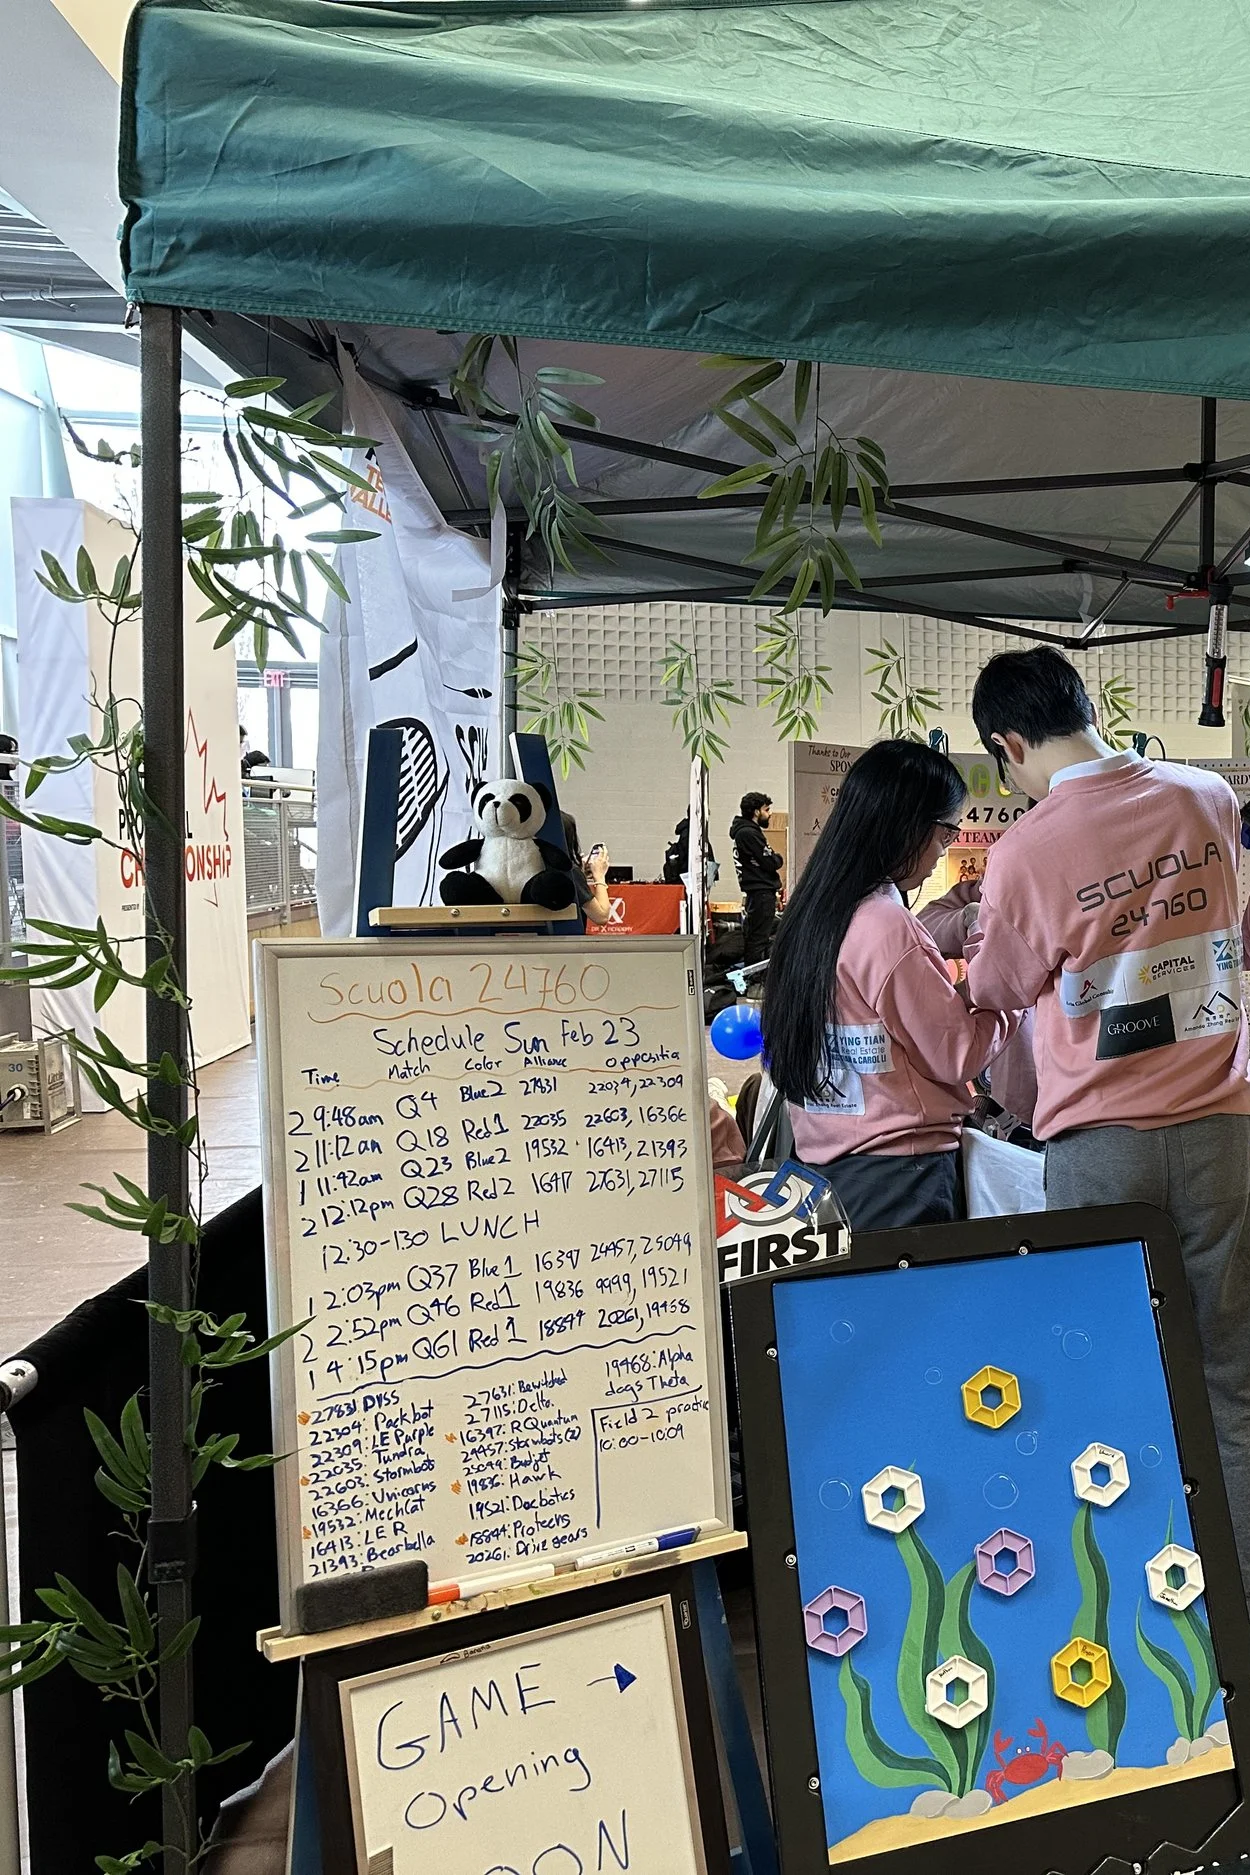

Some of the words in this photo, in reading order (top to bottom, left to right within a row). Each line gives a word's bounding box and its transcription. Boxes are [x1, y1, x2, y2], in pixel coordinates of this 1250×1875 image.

[263, 670, 287, 687] EXIT
[808, 746, 831, 758] Thanks
[832, 748, 839, 758] to
[120, 844, 232, 889] CHONSHIP
[1076, 842, 1222, 912] SCUOLA
[1111, 887, 1208, 937] 24760
[1151, 956, 1195, 973] CAPITAL
[1152, 964, 1196, 980] SERVICES
[321, 963, 452, 1006] Scuola
[469, 963, 610, 1008] 24760
[373, 1025, 485, 1056] Schedule
[504, 1022, 550, 1054] Sun
[561, 1020, 593, 1047] Feb
[602, 1017, 640, 1046] 23
[840, 1036, 861, 1046] YING
[864, 1034, 886, 1046] TIAN
[1107, 1015, 1161, 1036] GROOVE
[8, 1063, 23, 1073] 30
[301, 1068, 340, 1086] Time
[389, 1057, 431, 1080] Match
[464, 1056, 503, 1071] Color
[288, 1111, 313, 1135] 2
[294, 1150, 310, 1172] 2
[400, 1156, 452, 1179] Q23
[525, 1138, 569, 1162] 19532
[301, 1218, 317, 1237] 2
[403, 1185, 459, 1210] Q28
[441, 1210, 540, 1243] LUNCH
[717, 1222, 845, 1282] FIRST
[407, 1264, 458, 1292] Q37
[300, 1334, 319, 1363] 2
[407, 1295, 460, 1325] Q46
[535, 1280, 584, 1306] 19836
[642, 1268, 688, 1290] 19521
[412, 1329, 458, 1360] Q61
[646, 1370, 690, 1391] Theta
[394, 1422, 434, 1445] Purple
[600, 1407, 638, 1432] Field
[641, 1408, 659, 1419] 2
[372, 1442, 425, 1465] Tundra
[373, 1454, 435, 1484] Stormbots
[510, 1464, 562, 1489] Hawk
[376, 1663, 556, 1771] GAME
[404, 1745, 593, 1830] Opening
